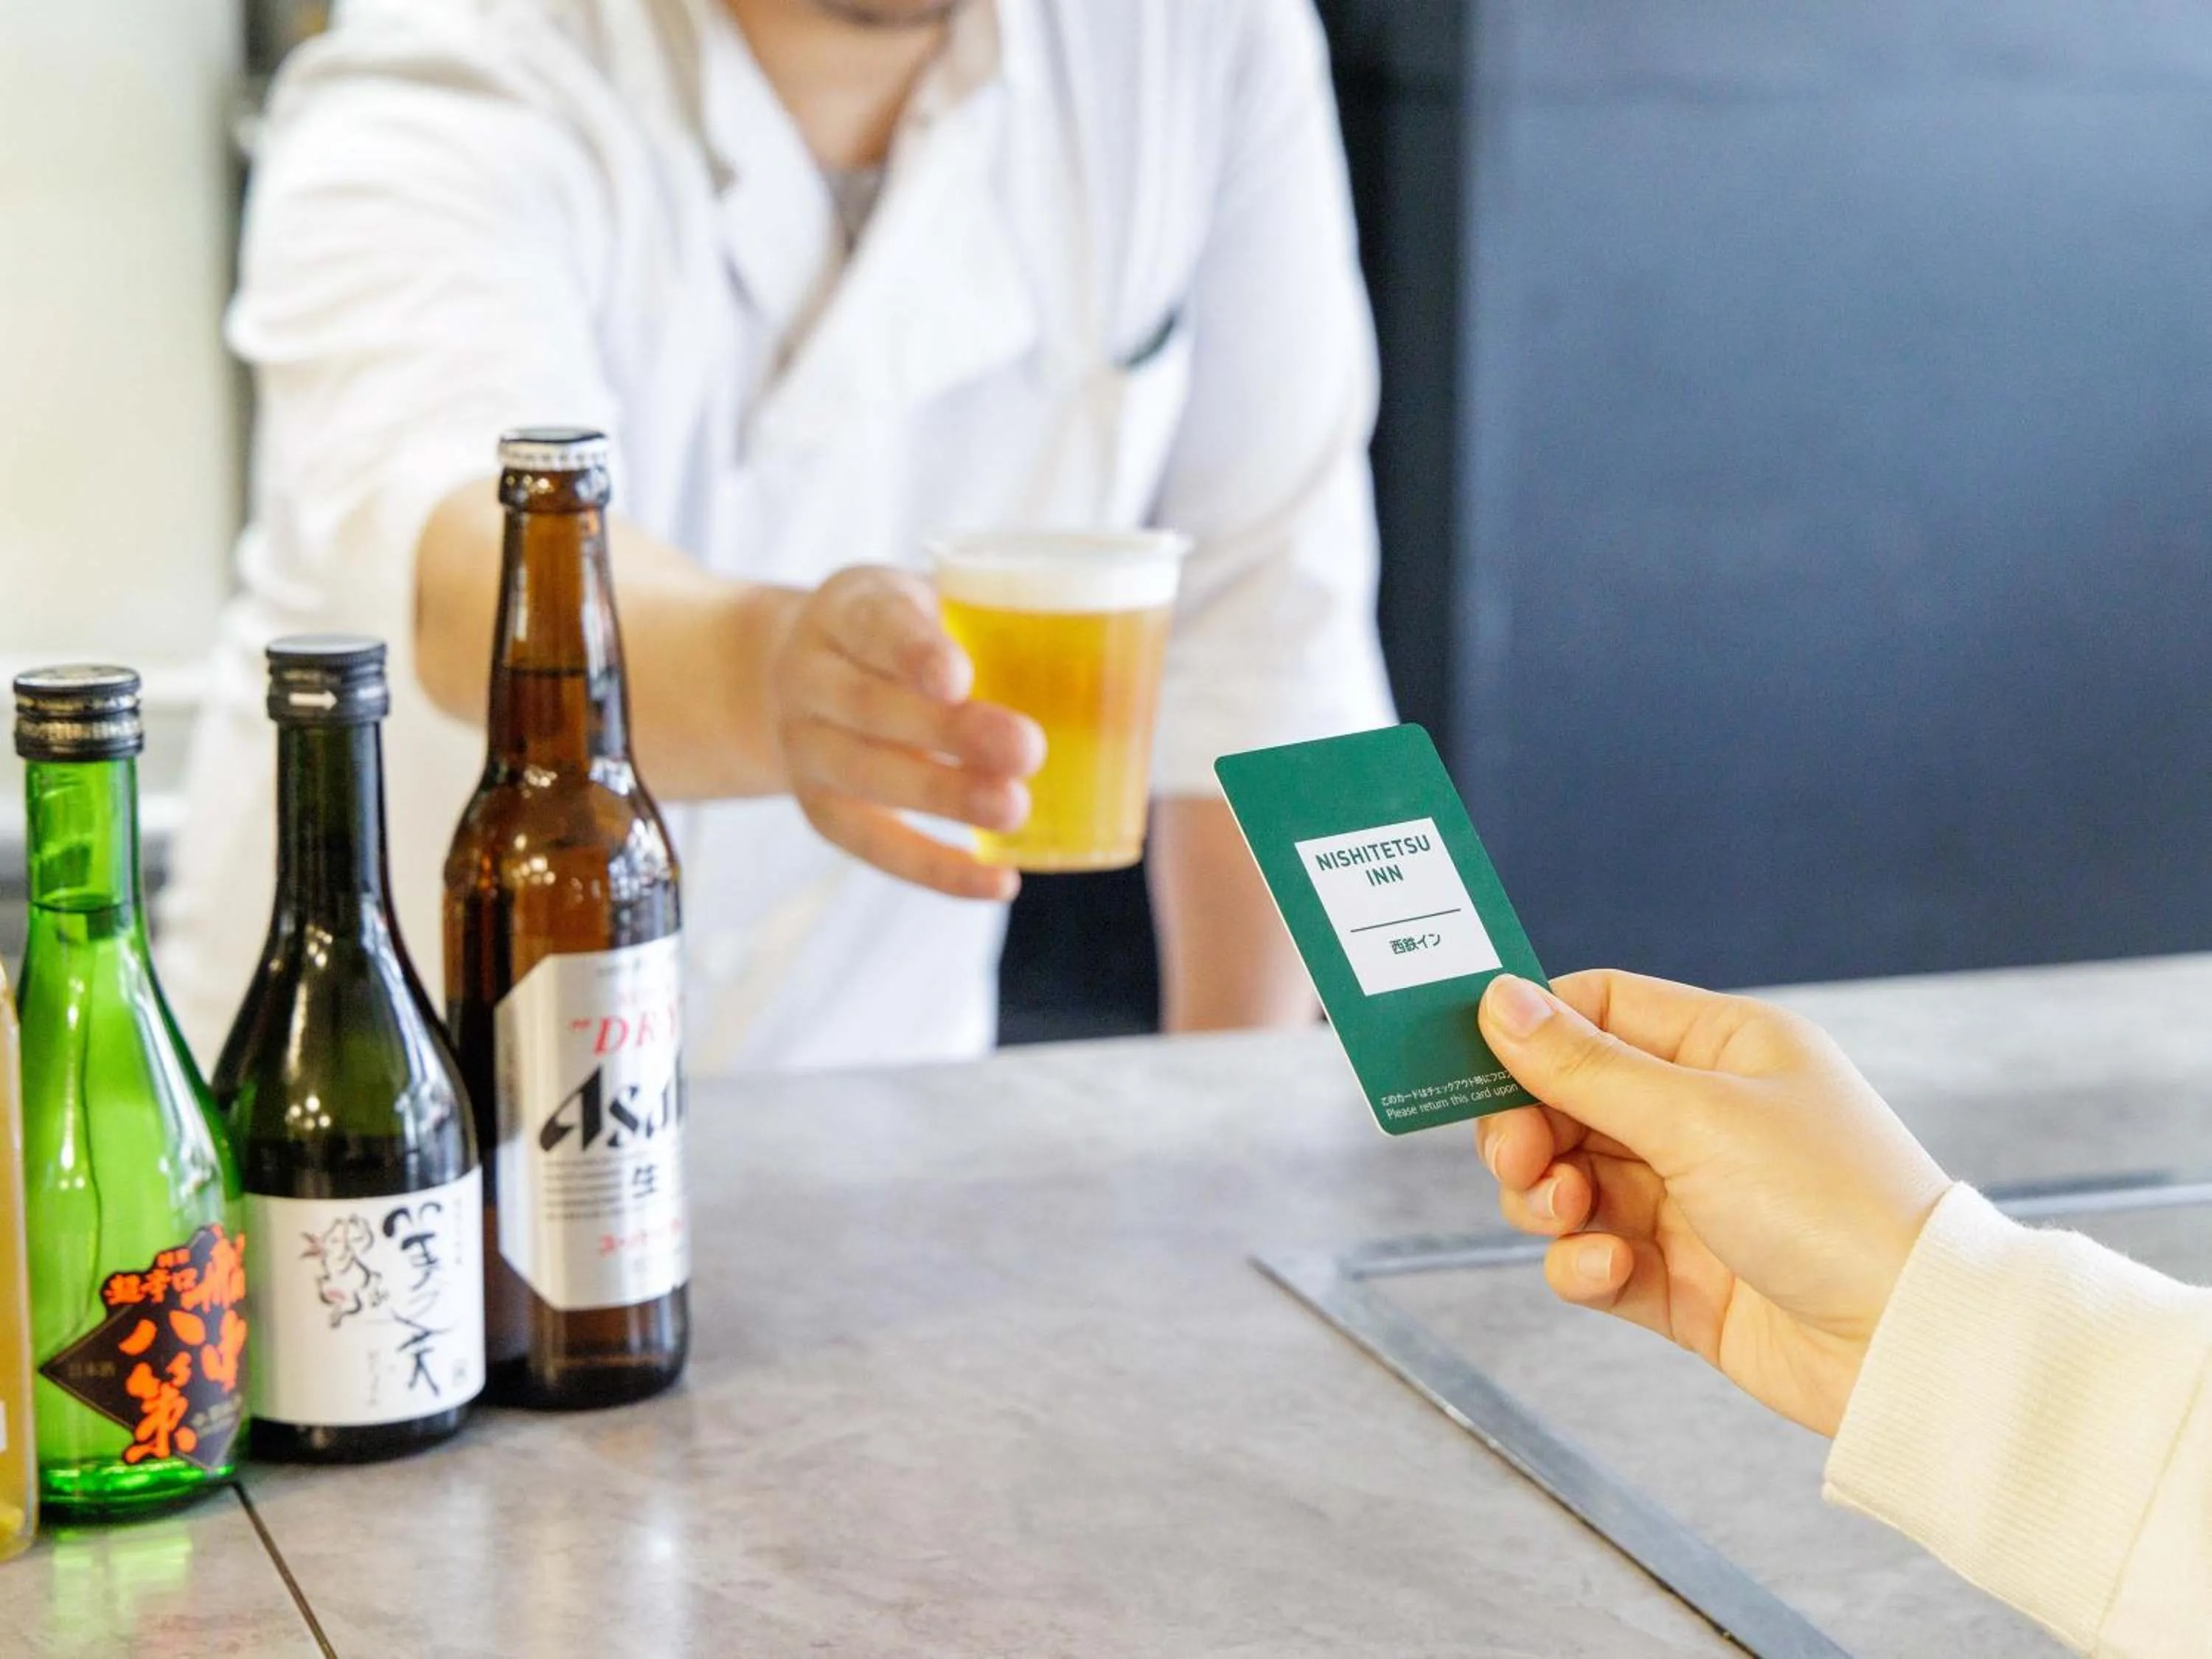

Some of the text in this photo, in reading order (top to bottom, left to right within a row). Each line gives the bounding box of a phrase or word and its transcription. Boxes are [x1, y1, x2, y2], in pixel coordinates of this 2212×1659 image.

[1315, 834, 1432, 872] NISHITETSU
[1365, 863, 1405, 887] INN
[1389, 933, 1441, 955] 西鉄イン
[1385, 1082, 1519, 1120] Please return this card upon
